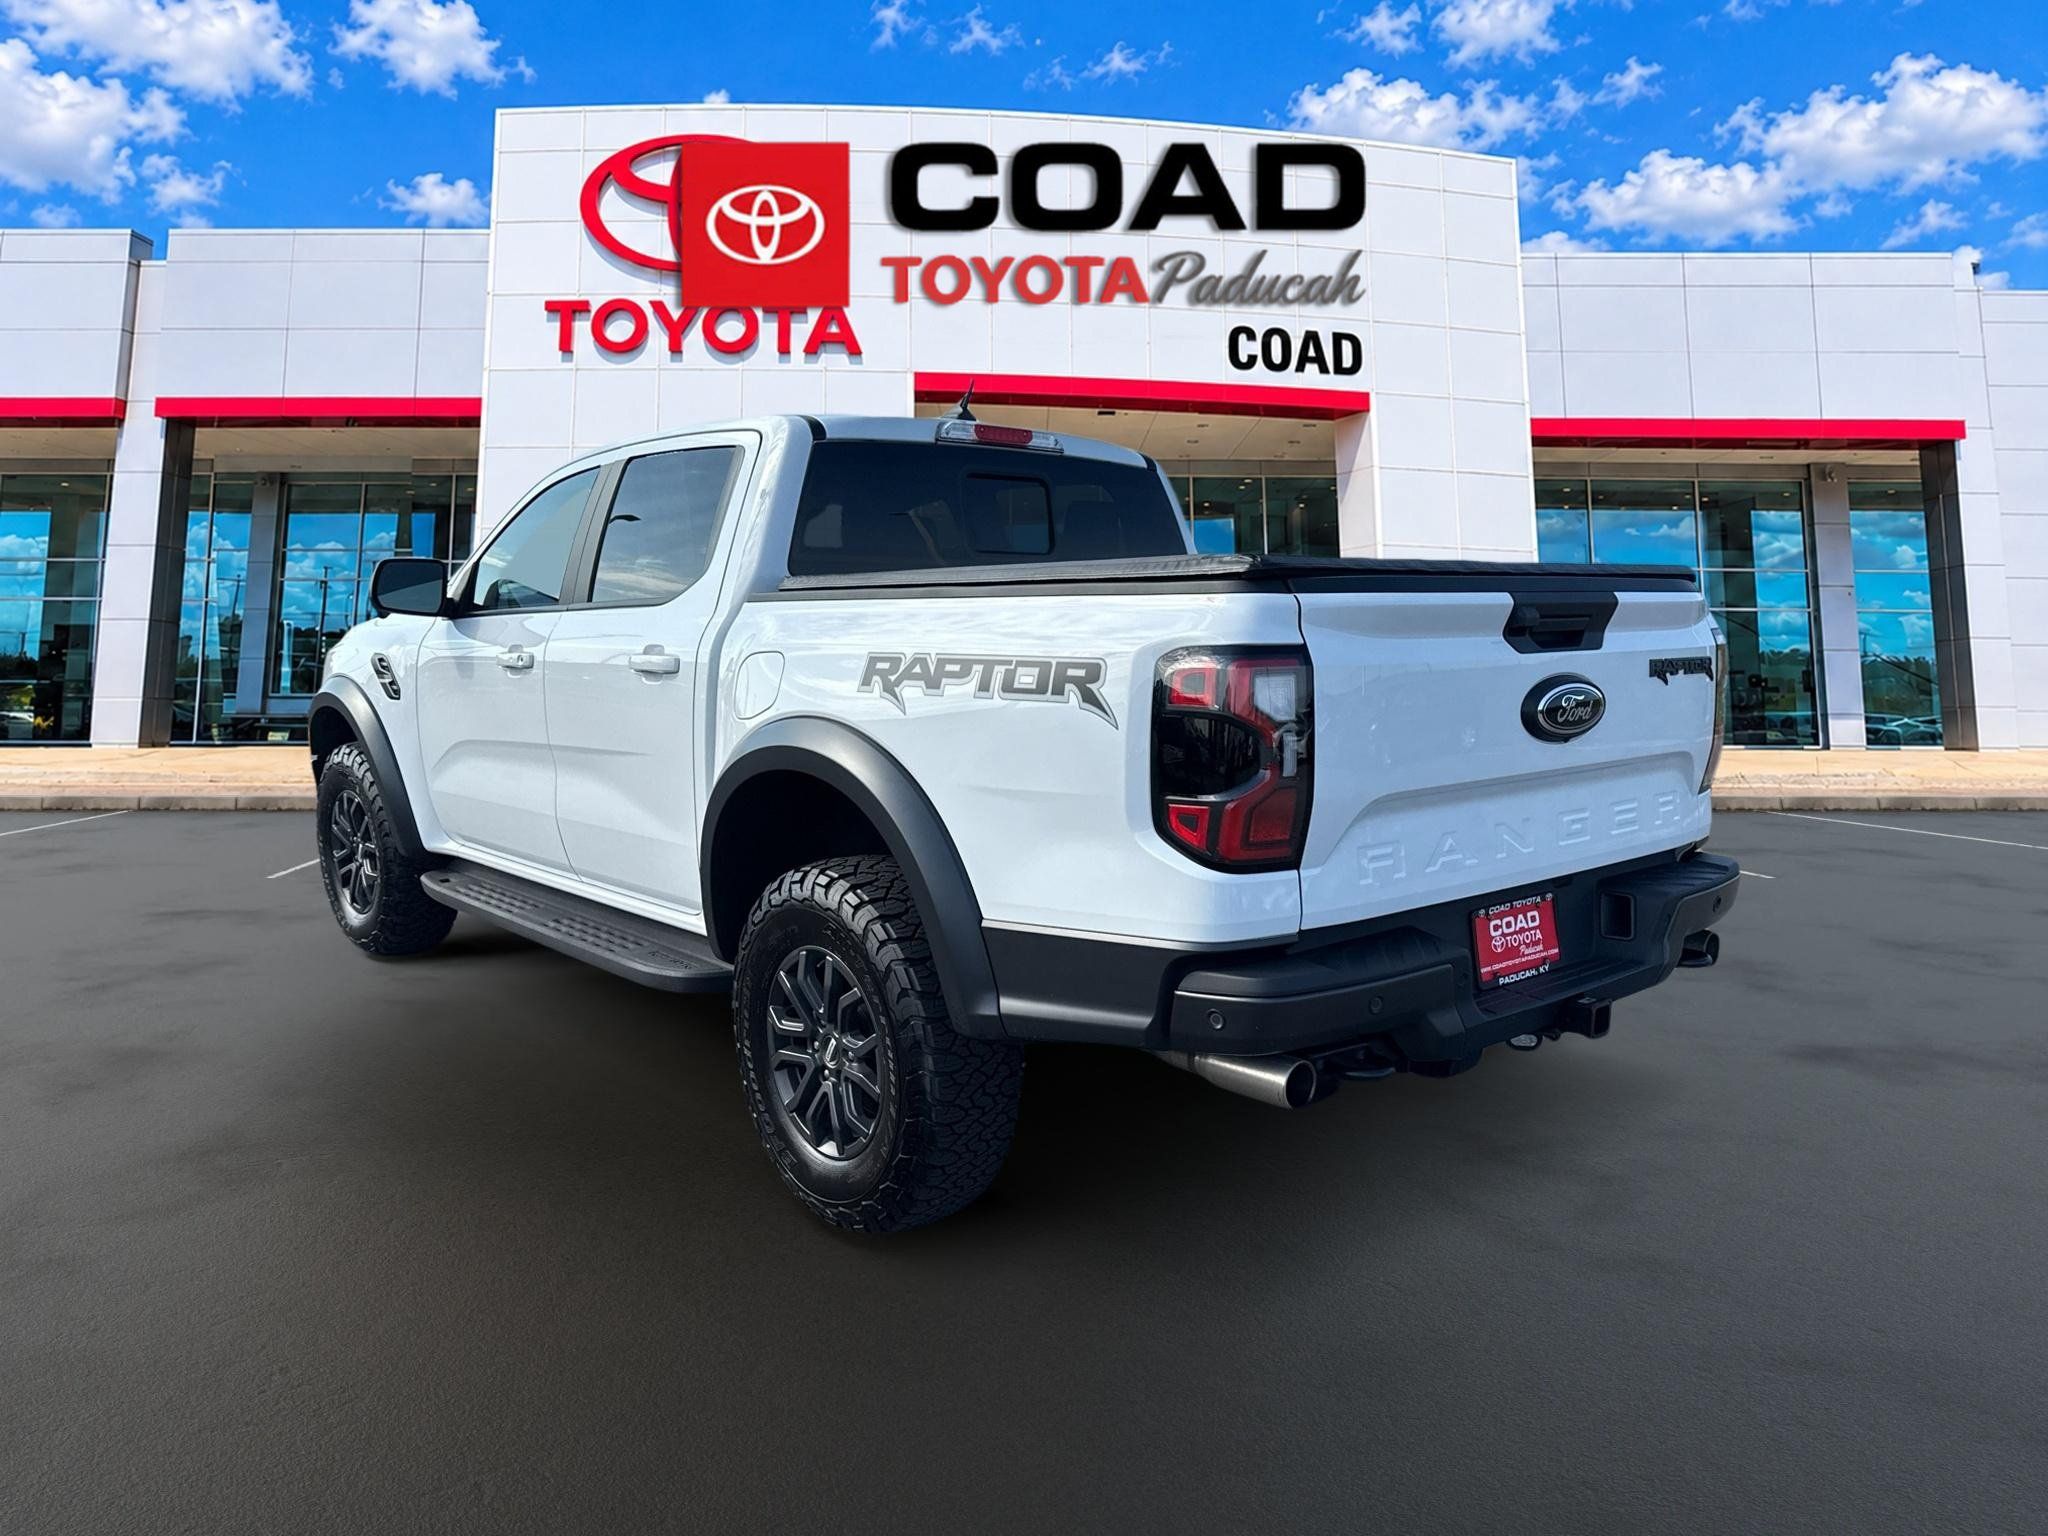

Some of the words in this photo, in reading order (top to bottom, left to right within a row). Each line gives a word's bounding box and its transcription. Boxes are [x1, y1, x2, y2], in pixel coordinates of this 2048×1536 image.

[545, 298, 862, 354] TOYOTA
[1228, 325, 1363, 375] COAD
[1649, 656, 1714, 686] RAPTOR
[857, 651, 1119, 730] RAPTOR
[1557, 695, 1594, 723] Ford
[1357, 790, 1682, 887] RANGER
[1489, 903, 1510, 914] COAD
[1512, 896, 1541, 908] TOYOTA
[1489, 910, 1540, 937] COAD
[1506, 930, 1542, 947] TOYOTA
[1539, 963, 1550, 973] KY
